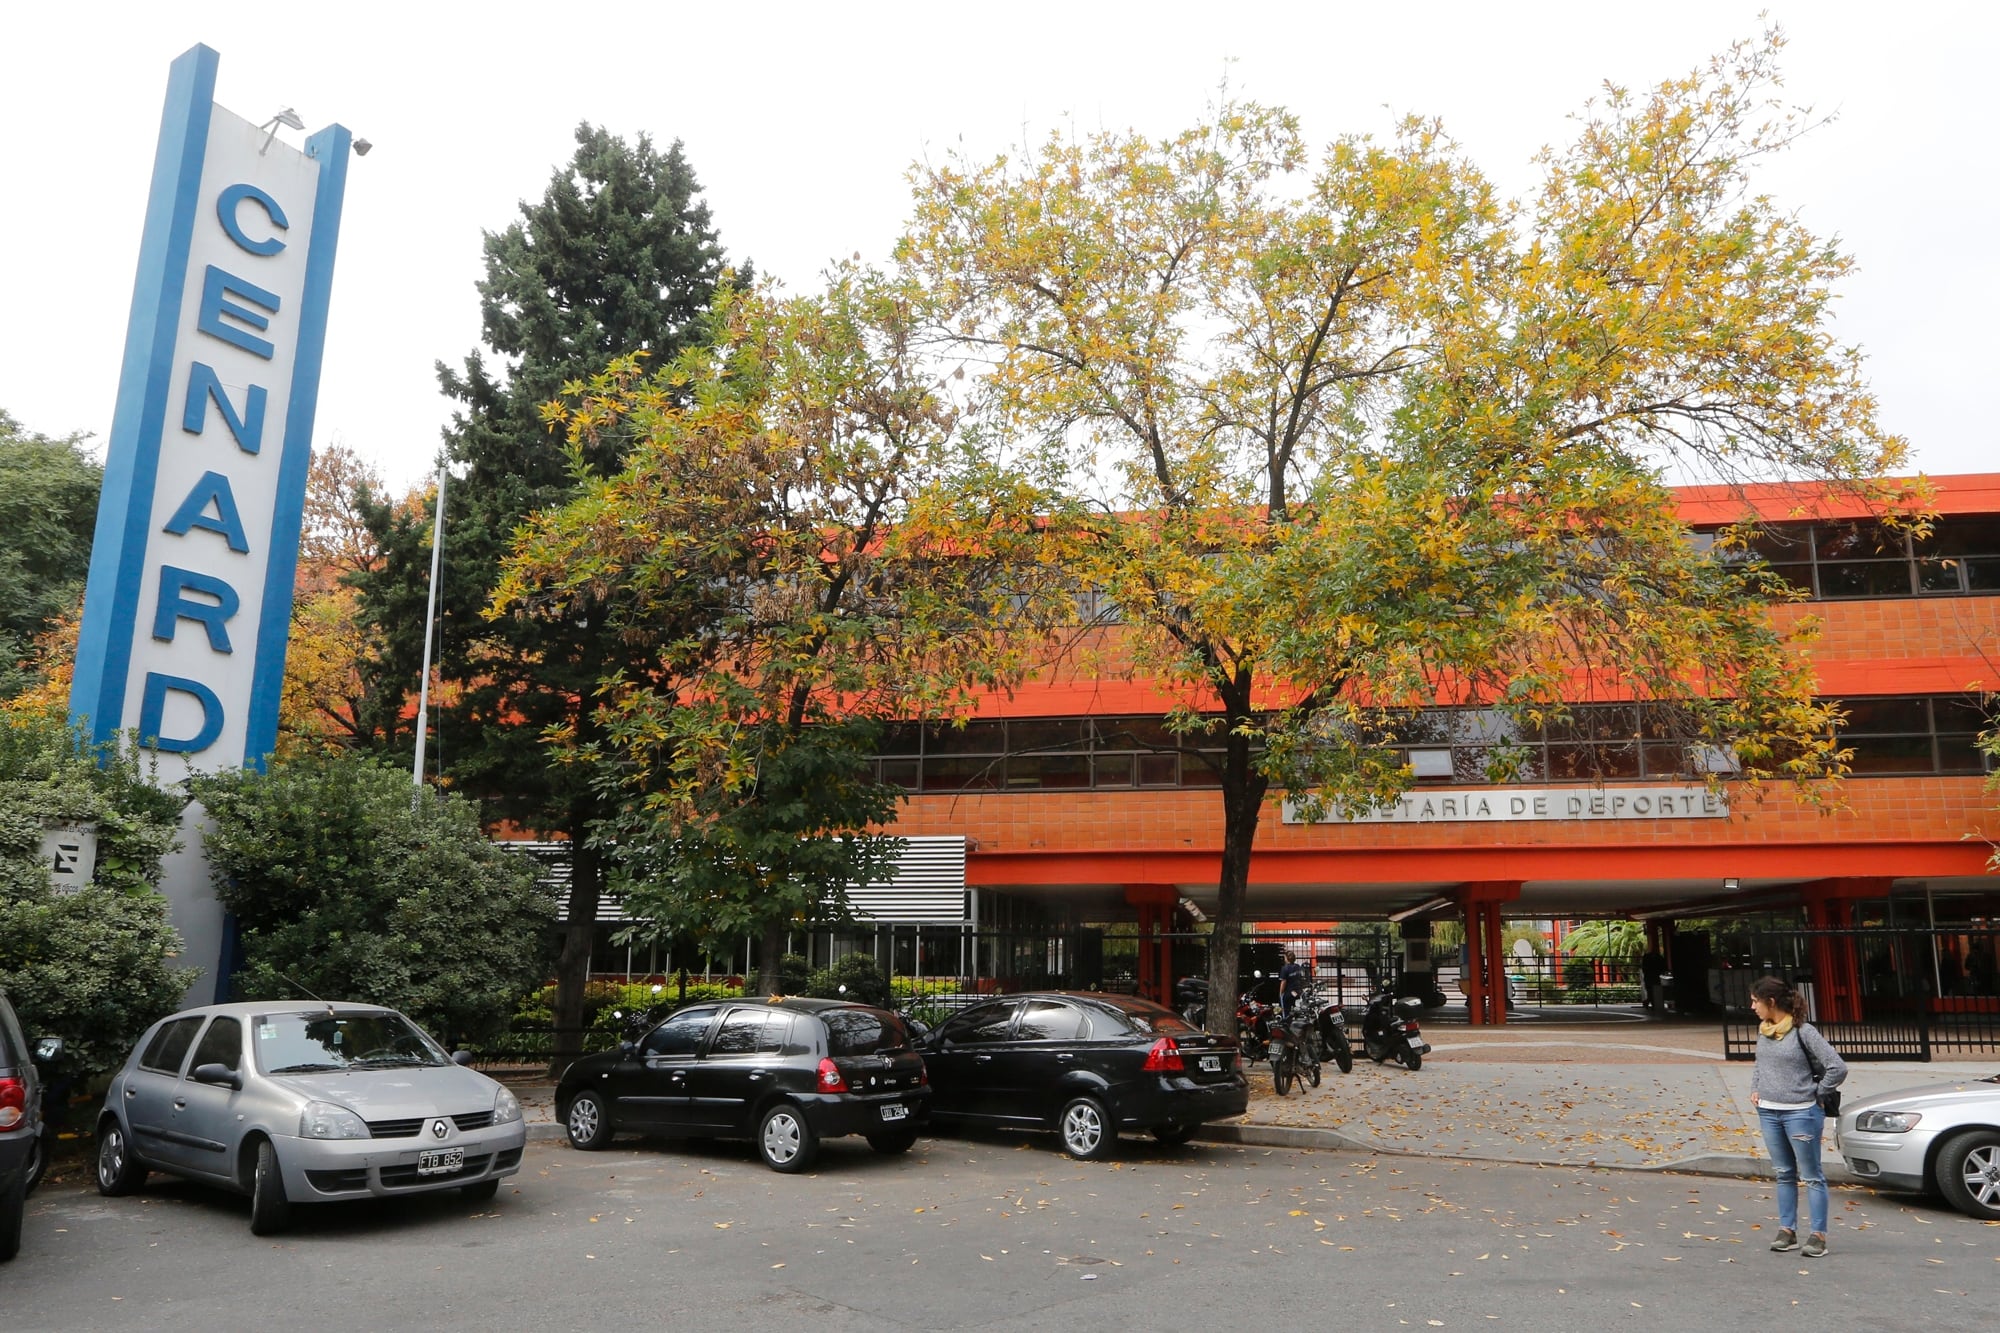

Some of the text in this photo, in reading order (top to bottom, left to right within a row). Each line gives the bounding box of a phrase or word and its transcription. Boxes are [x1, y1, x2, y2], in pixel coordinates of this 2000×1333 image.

[139, 184, 289, 752] CENARD
[1511, 796, 1547, 816] DE
[1567, 794, 1718, 815] DEPORTE
[444, 1152, 462, 1166] 852
